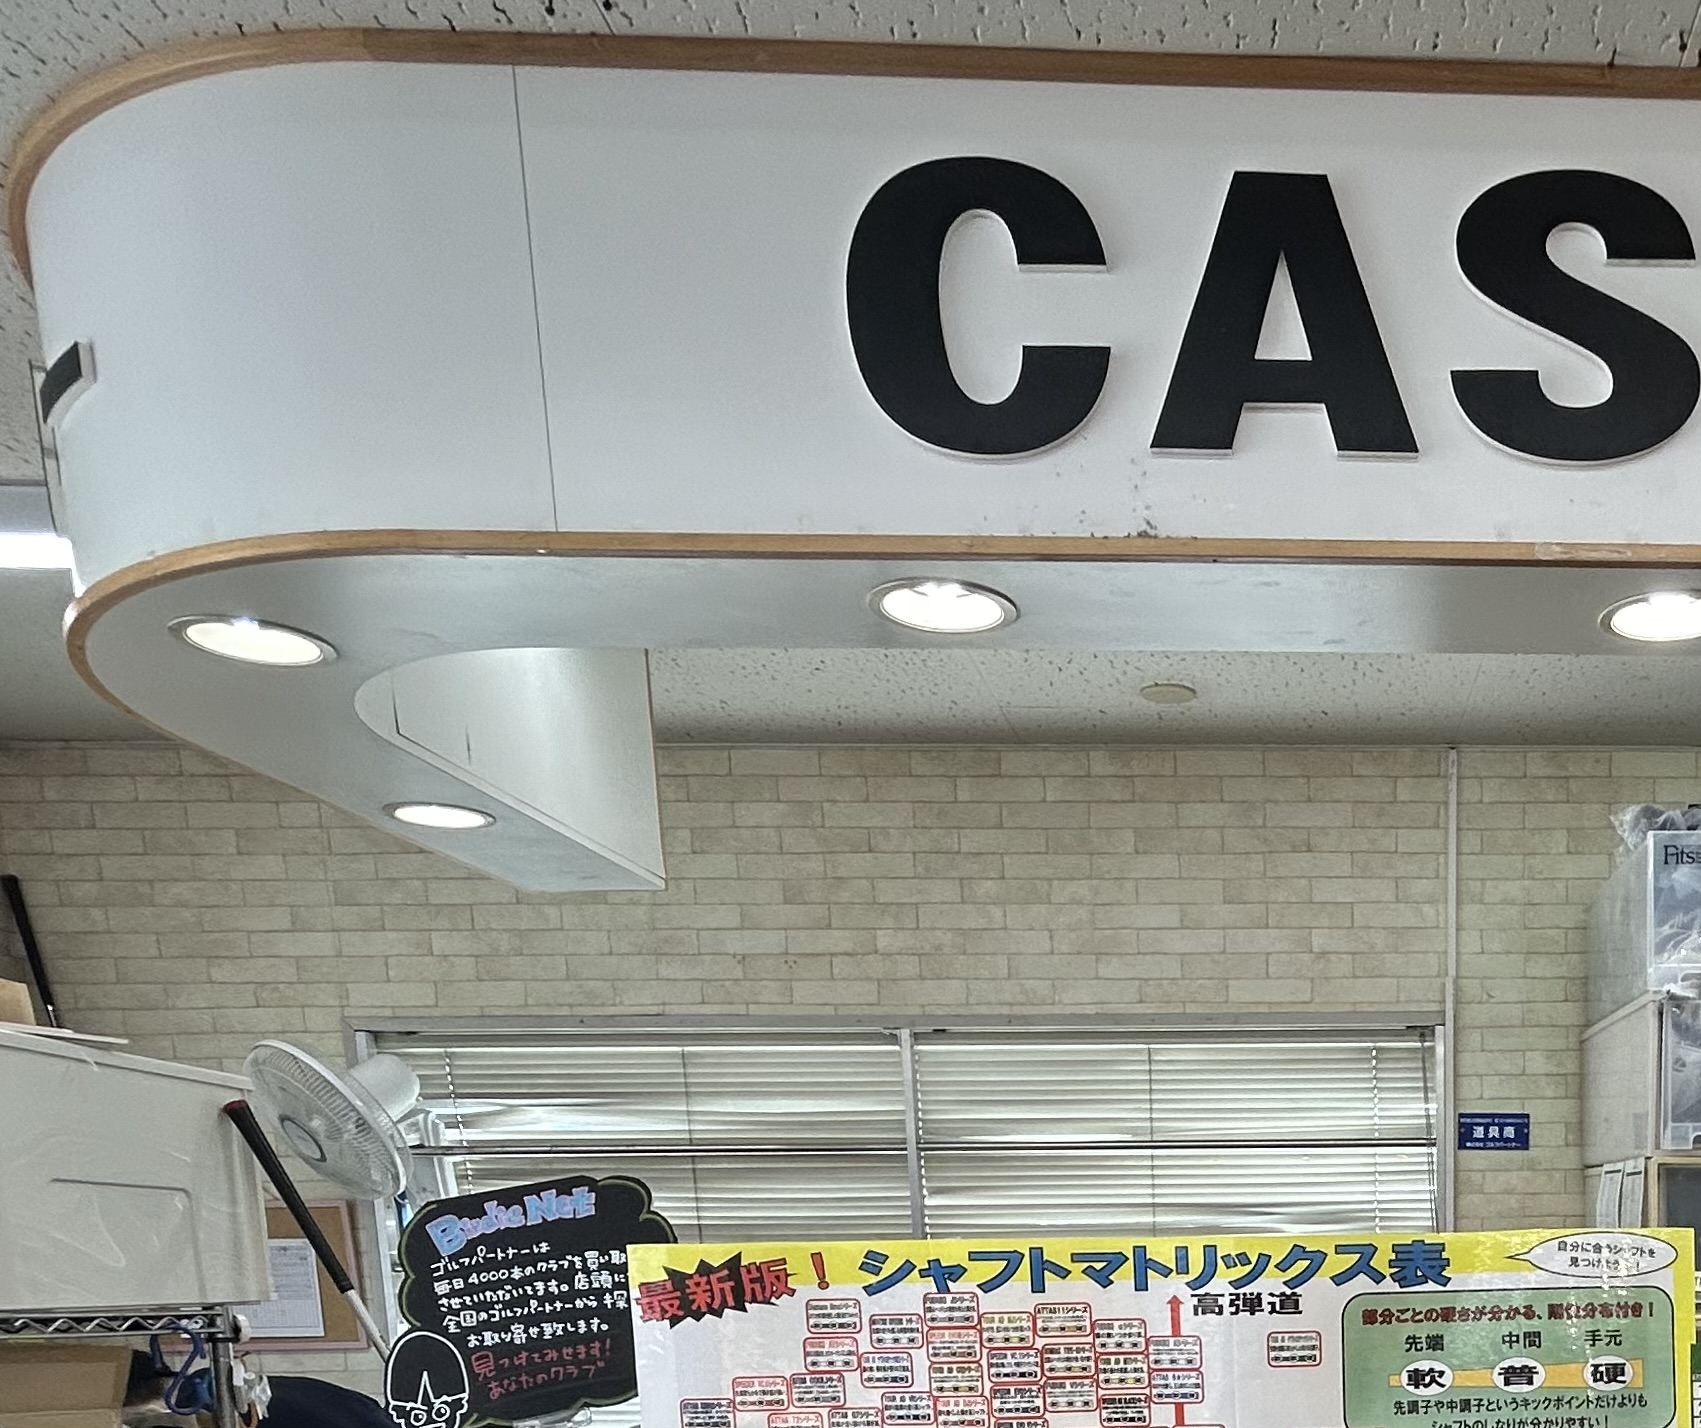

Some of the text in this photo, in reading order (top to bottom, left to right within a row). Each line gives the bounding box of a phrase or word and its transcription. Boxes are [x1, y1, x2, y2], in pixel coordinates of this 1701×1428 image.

[1663, 845, 1695, 865] Fits
[431, 1241, 550, 1277] ゴルフパートナーは
[858, 1239, 1451, 1296] シャフトマトリックス表
[1192, 1291, 1303, 1317] 高弾道
[1404, 1329, 1623, 1352] 先端 中間 手元
[1405, 1362, 1628, 1390] 軟 普 硬
